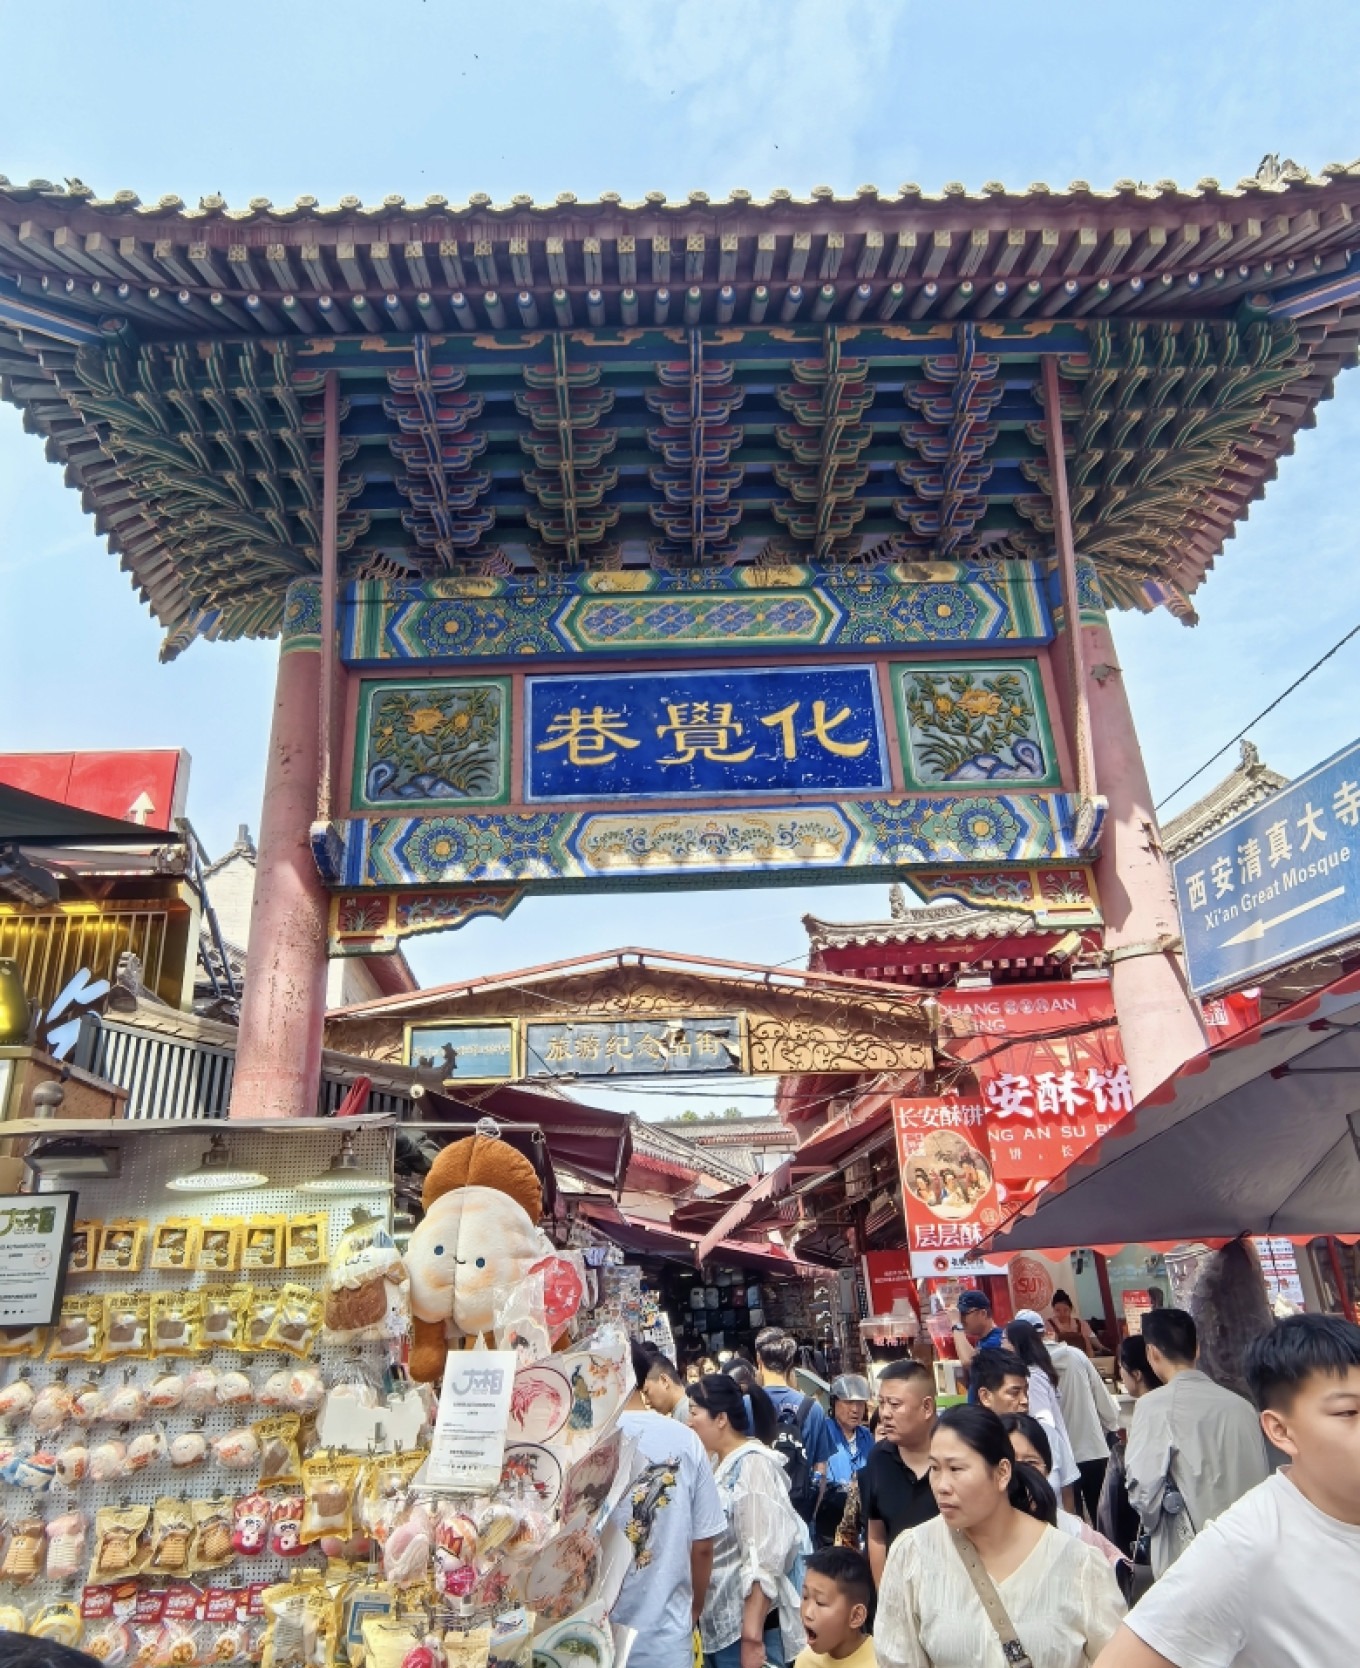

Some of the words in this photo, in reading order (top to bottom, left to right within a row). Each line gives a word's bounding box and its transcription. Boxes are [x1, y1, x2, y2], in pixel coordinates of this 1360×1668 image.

[1185, 780, 1360, 912] 西安清真大寺
[1204, 901, 1240, 931] Xi'an
[1241, 879, 1280, 912] Great
[1282, 846, 1350, 892] Mosque
[985, 1065, 1133, 1118] 安酥饼
[896, 1104, 984, 1128] 长安酥饼
[1024, 1127, 1051, 1139] AN
[1061, 1125, 1086, 1137] SU
[915, 1222, 983, 1248] 层层酥
